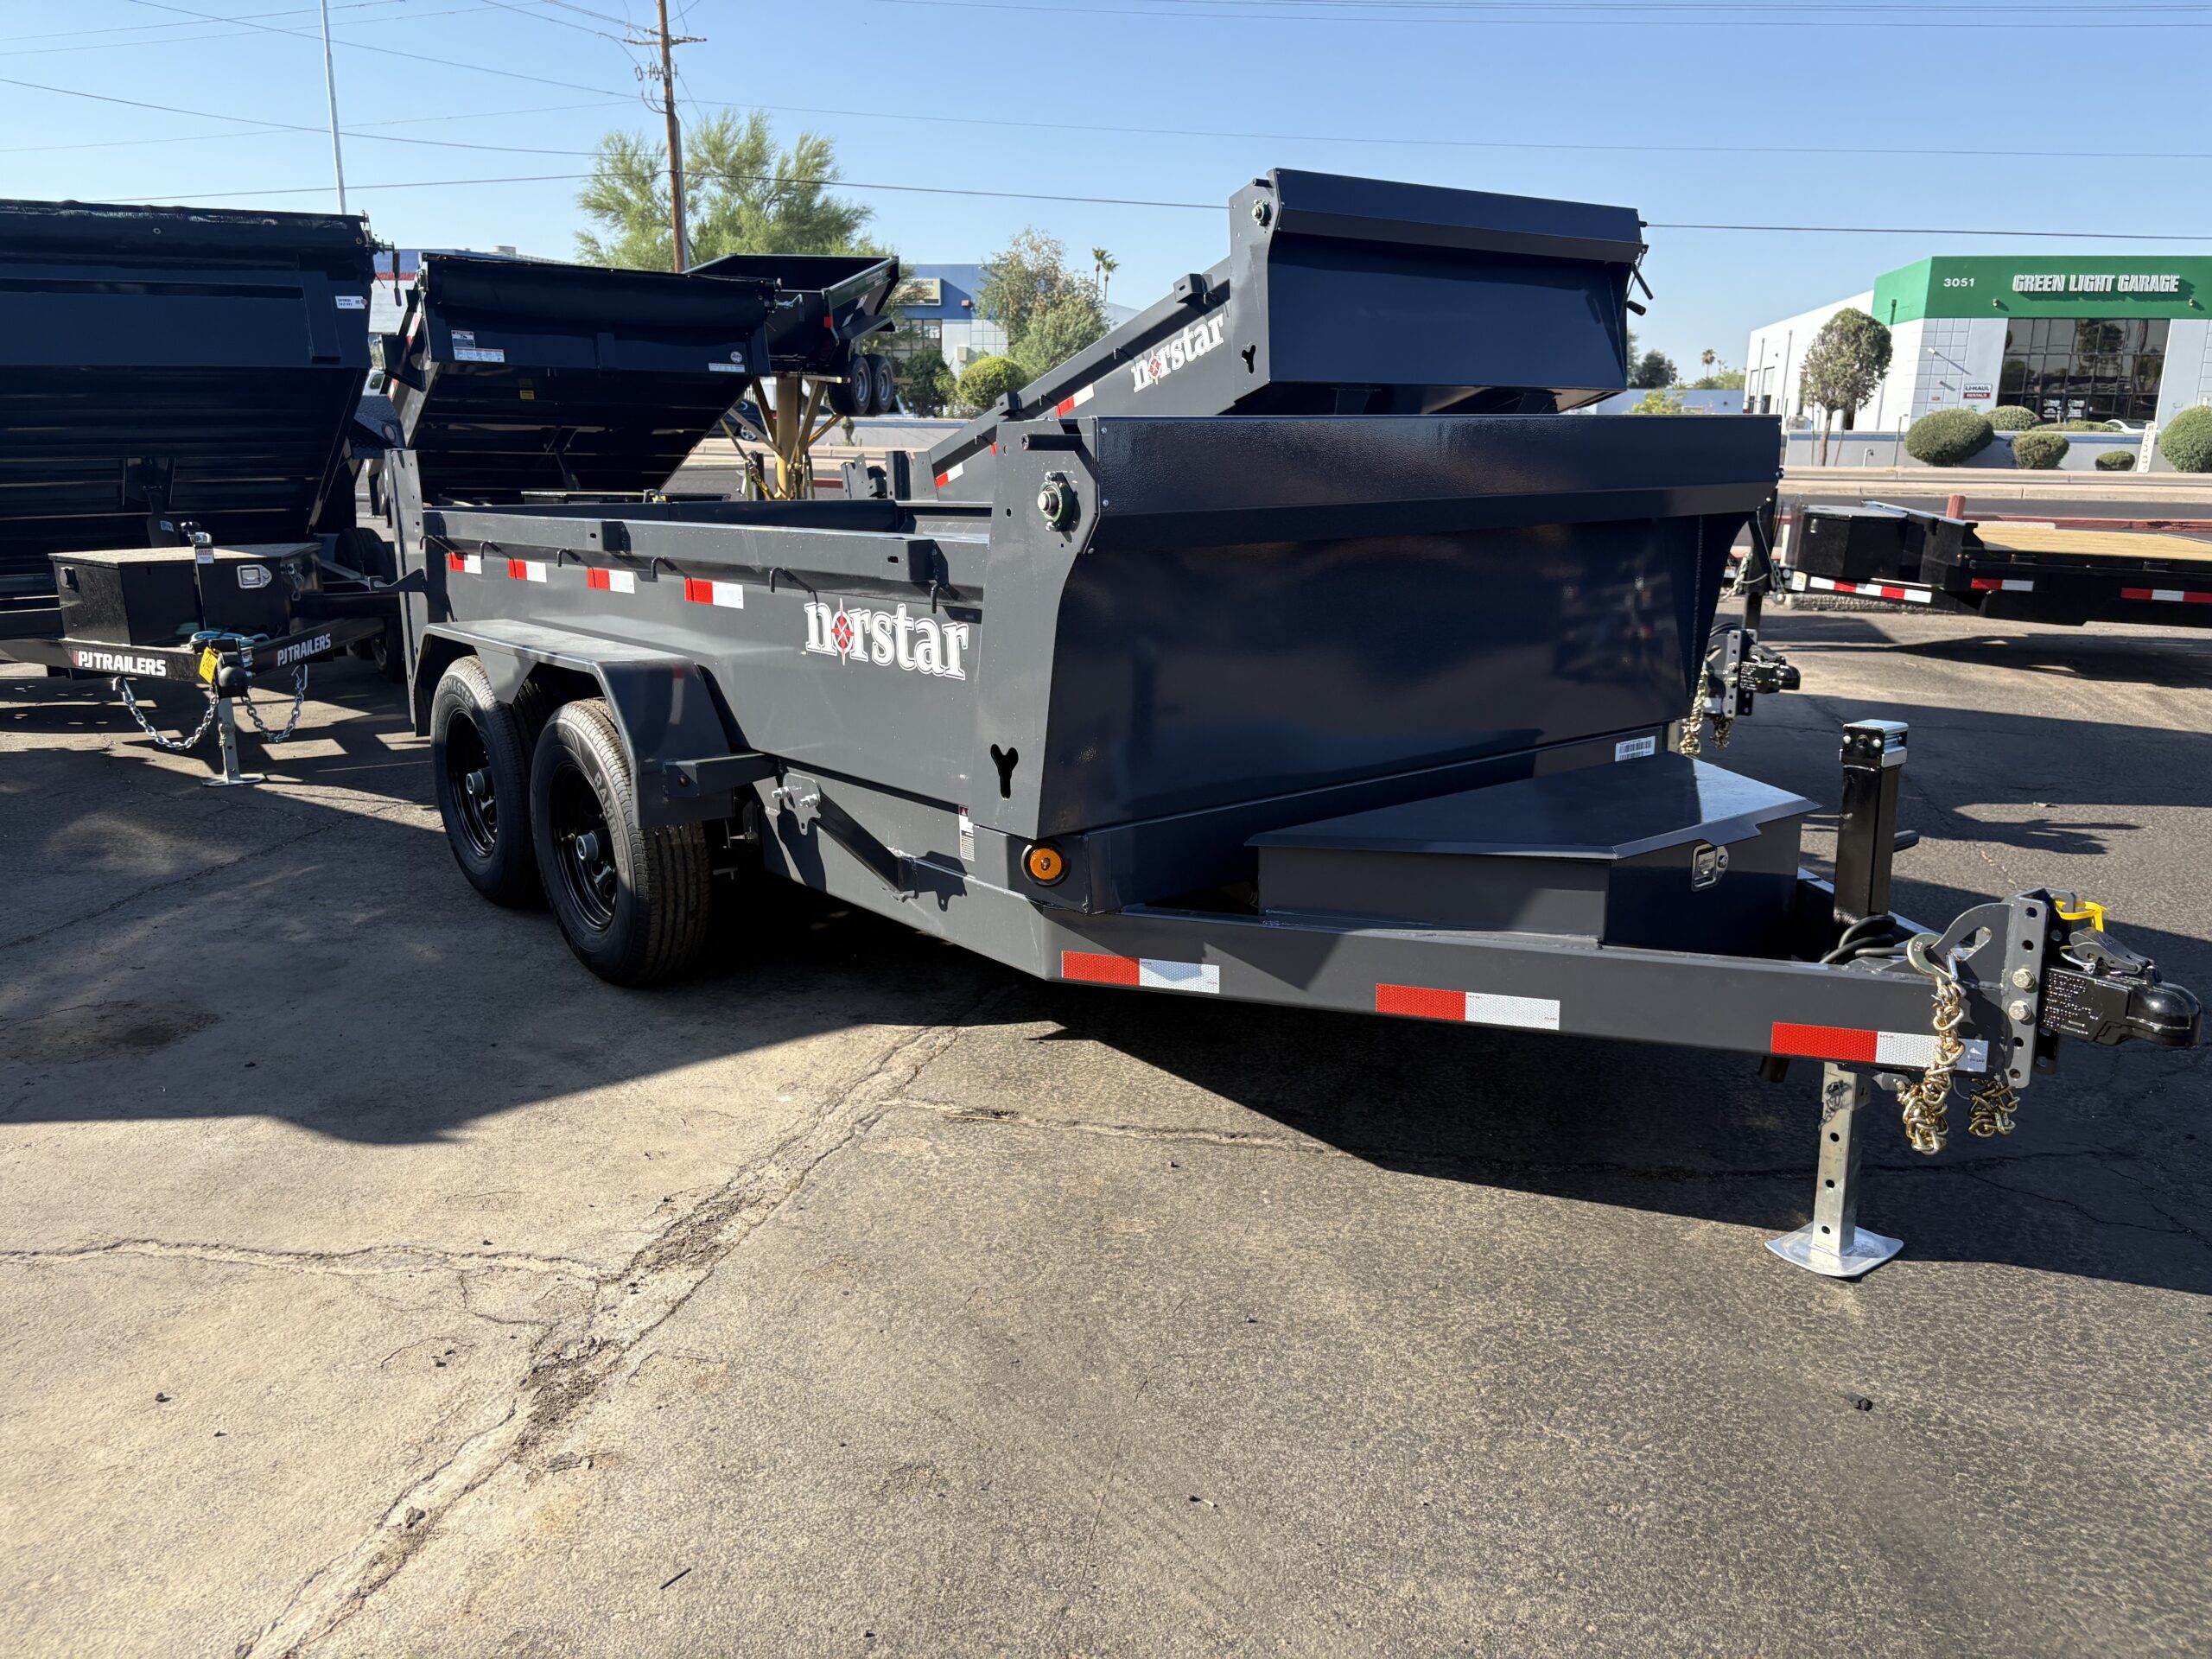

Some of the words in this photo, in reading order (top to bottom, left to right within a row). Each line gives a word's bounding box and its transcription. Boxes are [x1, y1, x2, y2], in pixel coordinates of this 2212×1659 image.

[1943, 277, 1975, 288] 3051
[2012, 274, 2065, 292] GREEN
[2069, 274, 2115, 292] LIGHT
[2117, 274, 2180, 292] GARAGE
[1130, 313, 1224, 393] norstar
[804, 597, 969, 681] norstar
